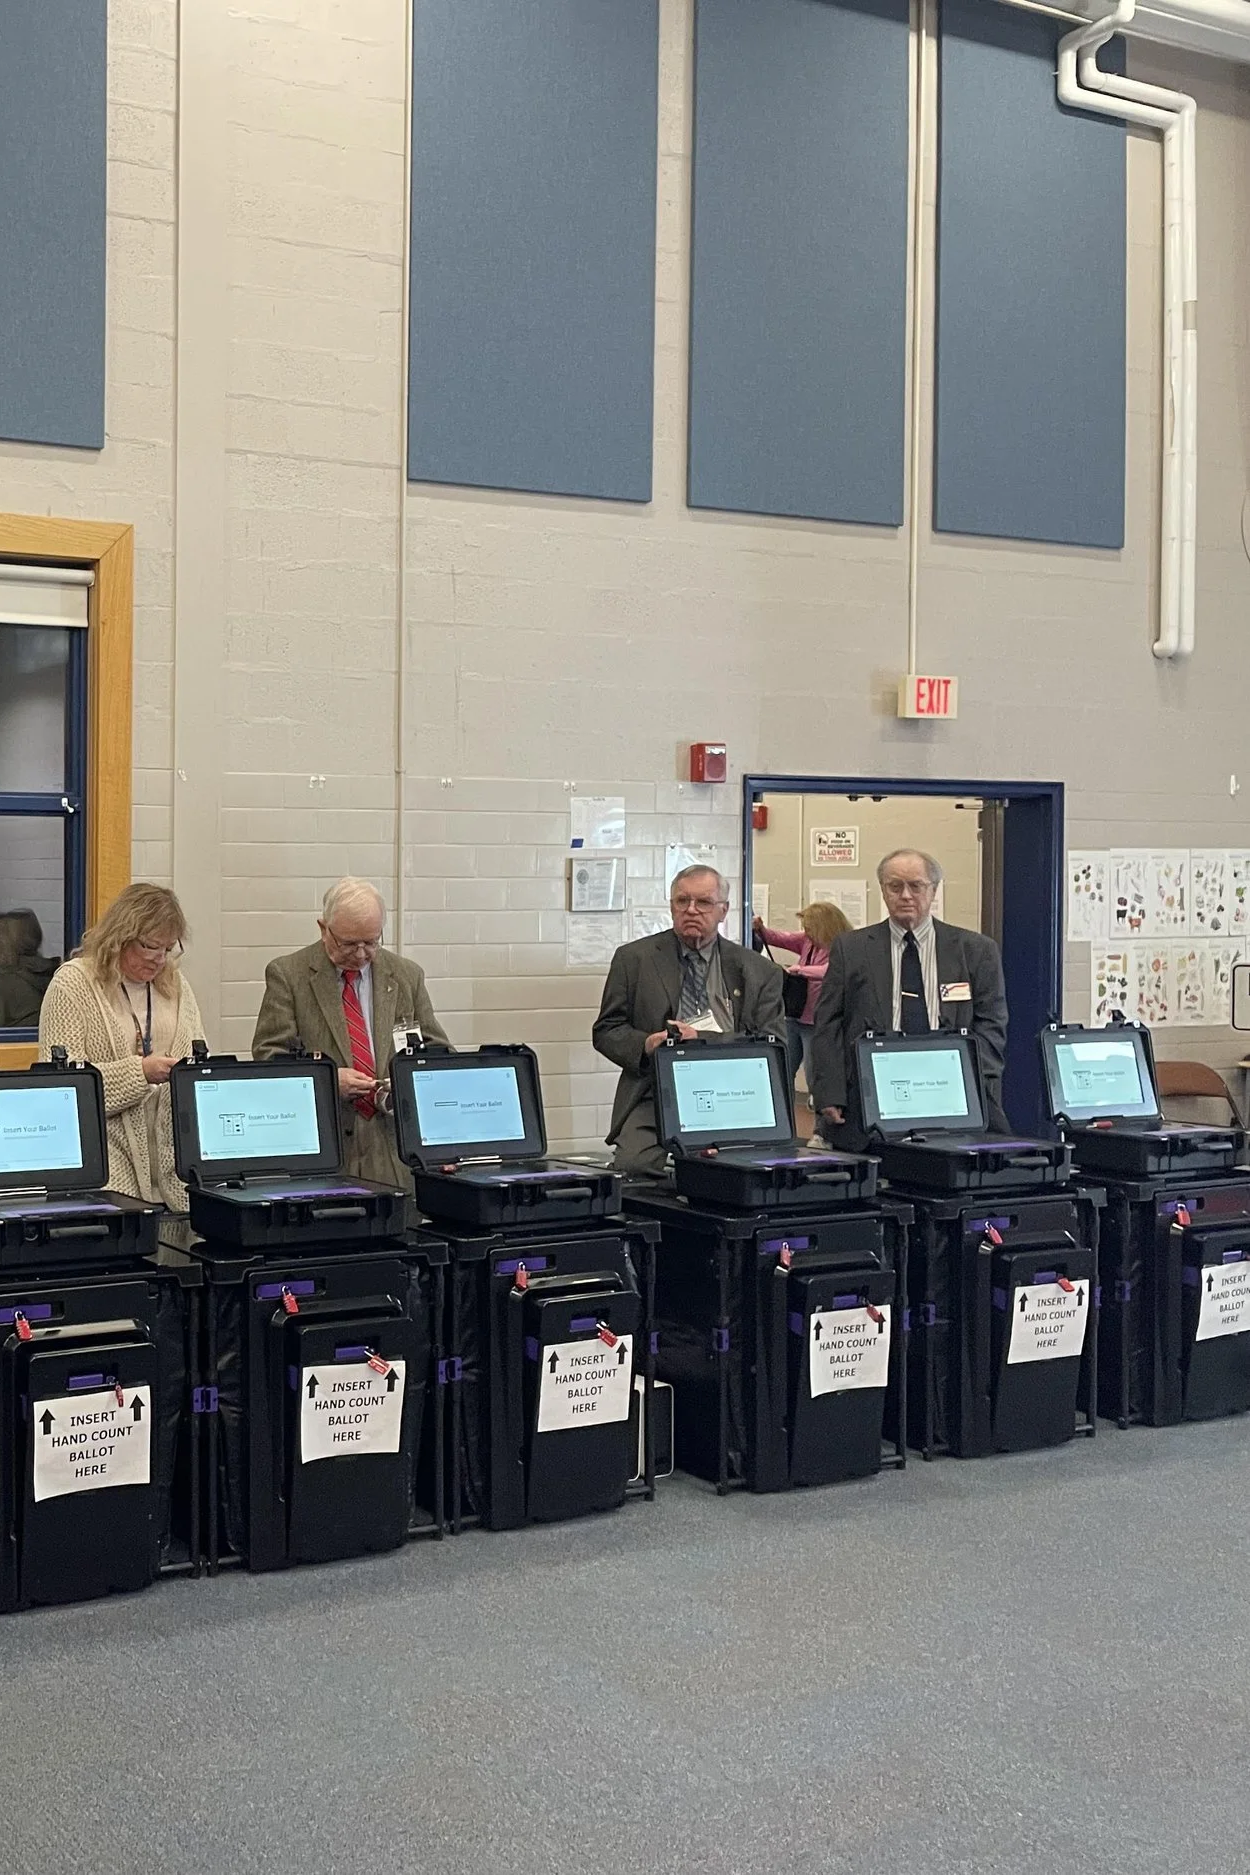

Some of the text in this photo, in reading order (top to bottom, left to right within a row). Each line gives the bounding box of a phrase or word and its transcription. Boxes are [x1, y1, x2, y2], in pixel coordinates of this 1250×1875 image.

[917, 679, 951, 714] EXIT
[1222, 1275, 1246, 1286] INSERT
[1211, 1287, 1250, 1301] HAND COUN
[1037, 1297, 1066, 1307] INSERT
[1220, 1301, 1244, 1312] BALLOT
[1024, 1310, 1076, 1322] HAND COUNT
[1222, 1315, 1239, 1324] HERE
[833, 1324, 866, 1335] INSERT
[1034, 1325, 1064, 1335] BALLOT
[819, 1338, 877, 1351] HAND COUNT
[1037, 1339, 1057, 1348] HERE
[570, 1354, 605, 1367] INSERT
[830, 1353, 864, 1364] BALLOT
[556, 1369, 618, 1384] HAND COUNT
[833, 1368, 856, 1378] HERE
[332, 1380, 372, 1392] INSERT
[568, 1386, 603, 1398] BALLOT
[314, 1396, 386, 1410] HAND COUNT
[572, 1402, 597, 1414] HERE
[70, 1410, 116, 1426] INSERT
[328, 1414, 370, 1426] BALLOT
[52, 1426, 133, 1448] HAND COUNT
[333, 1431, 362, 1442] HERE
[70, 1446, 115, 1462] BALLOT
[75, 1464, 106, 1478] HERE
